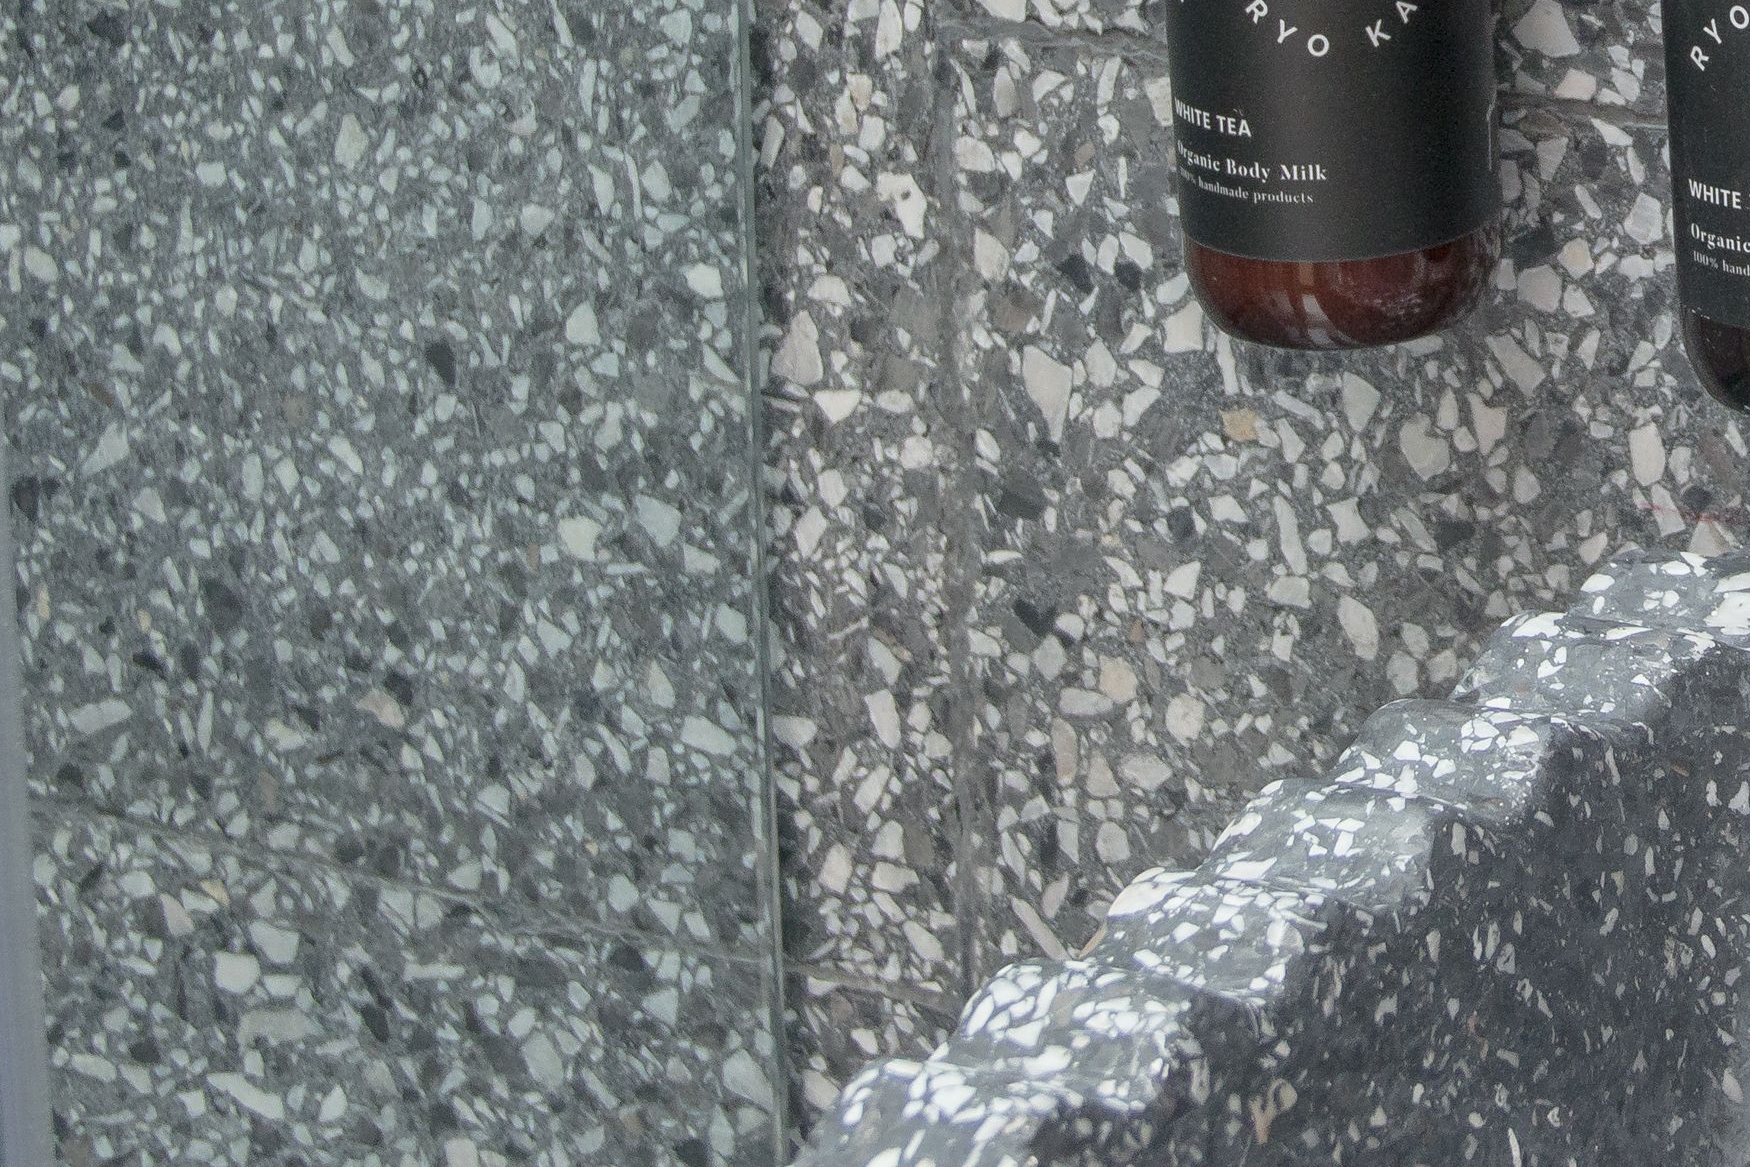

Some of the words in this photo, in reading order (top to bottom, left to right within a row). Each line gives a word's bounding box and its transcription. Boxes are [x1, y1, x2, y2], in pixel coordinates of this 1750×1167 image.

[1689, 4, 1750, 72] RYO
[1174, 97, 1211, 130] WHITE
[1215, 115, 1253, 138] TEA
[1177, 139, 1221, 172] Organic
[1226, 158, 1271, 184] Body
[1280, 163, 1329, 182] Milk
[1198, 175, 1250, 200] handmade
[1253, 189, 1314, 205] products
[1688, 178, 1742, 210] WHITE
[1692, 250, 1719, 271] 100%
